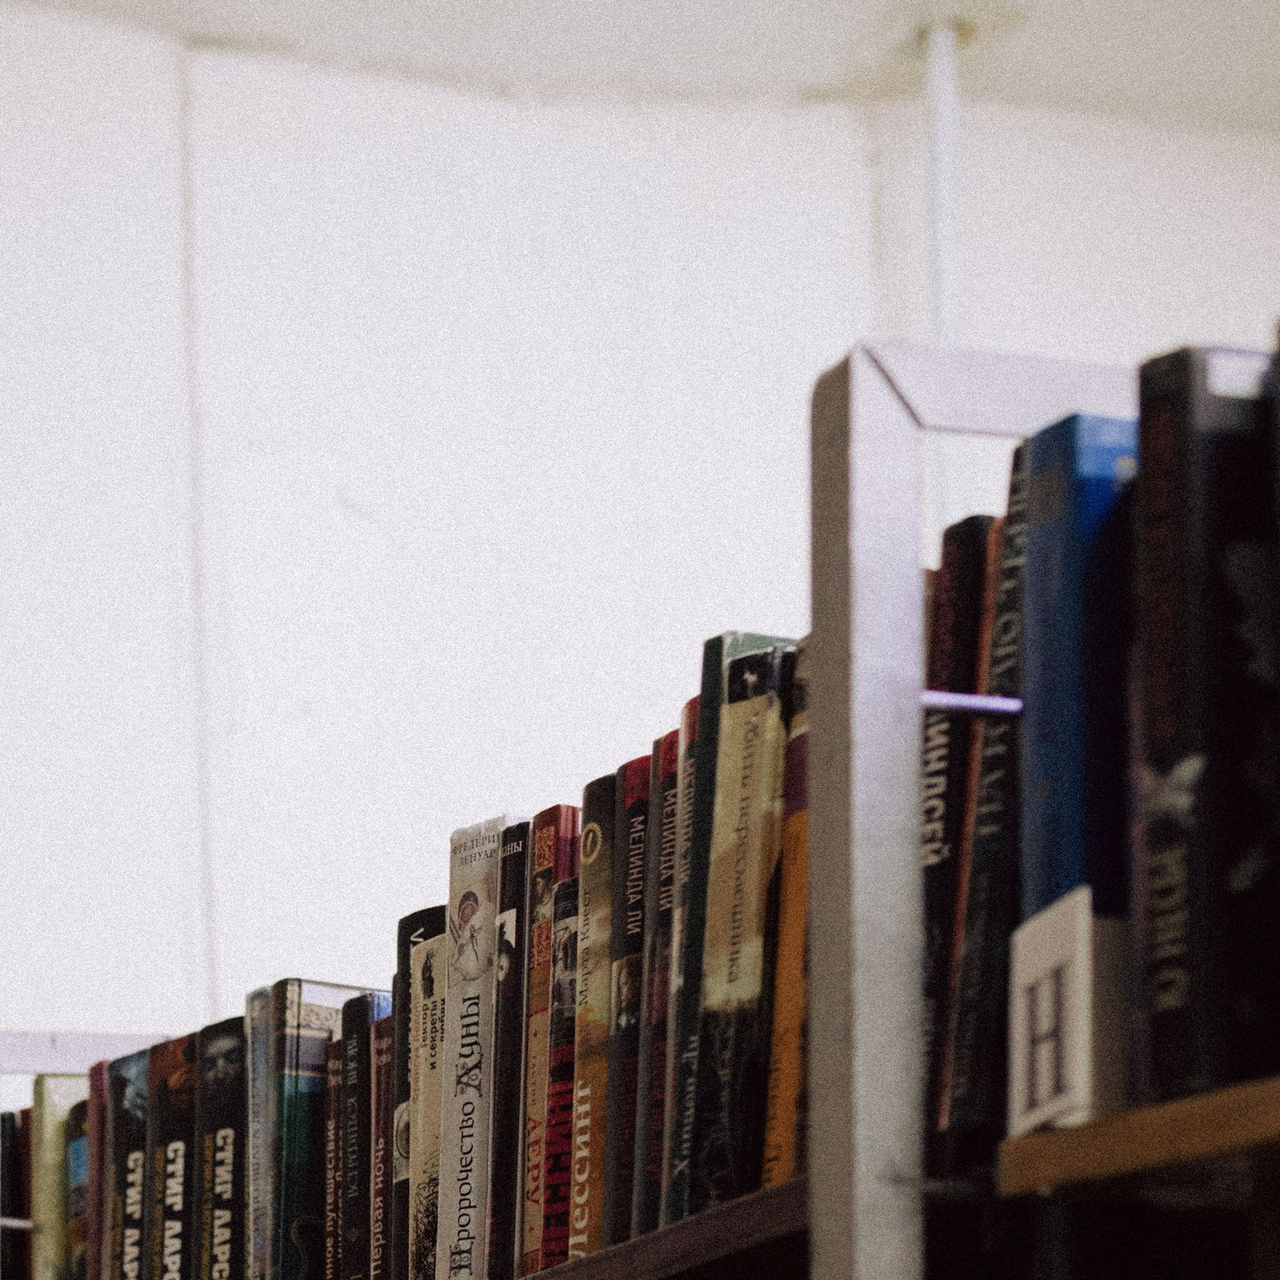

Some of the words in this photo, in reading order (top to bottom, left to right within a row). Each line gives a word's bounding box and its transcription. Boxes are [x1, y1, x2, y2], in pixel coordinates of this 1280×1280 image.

[626, 815, 648, 905] МЕЛИНДА
[659, 787, 679, 881] МЕЛИНДА
[579, 887, 591, 942] Квест
[624, 909, 643, 936] ЛИ
[659, 886, 676, 912] ЛИ
[727, 797, 753, 984] пересмешника
[578, 946, 592, 1007] Марта
[428, 1000, 439, 1058] секреты
[453, 993, 484, 1098] Луны
[1027, 962, 1066, 1112] Н
[124, 1149, 145, 1220] СТИГ
[165, 1139, 187, 1212] СТИГ
[214, 1127, 236, 1200] СТИГ
[323, 1118, 336, 1232] путешествие
[372, 1137, 386, 1189] ночь
[448, 1100, 477, 1280] Пророчество
[527, 1115, 542, 1207] ЛЕРУ
[568, 1079, 592, 1259] Лессинг
[371, 1195, 386, 1276] Первая
